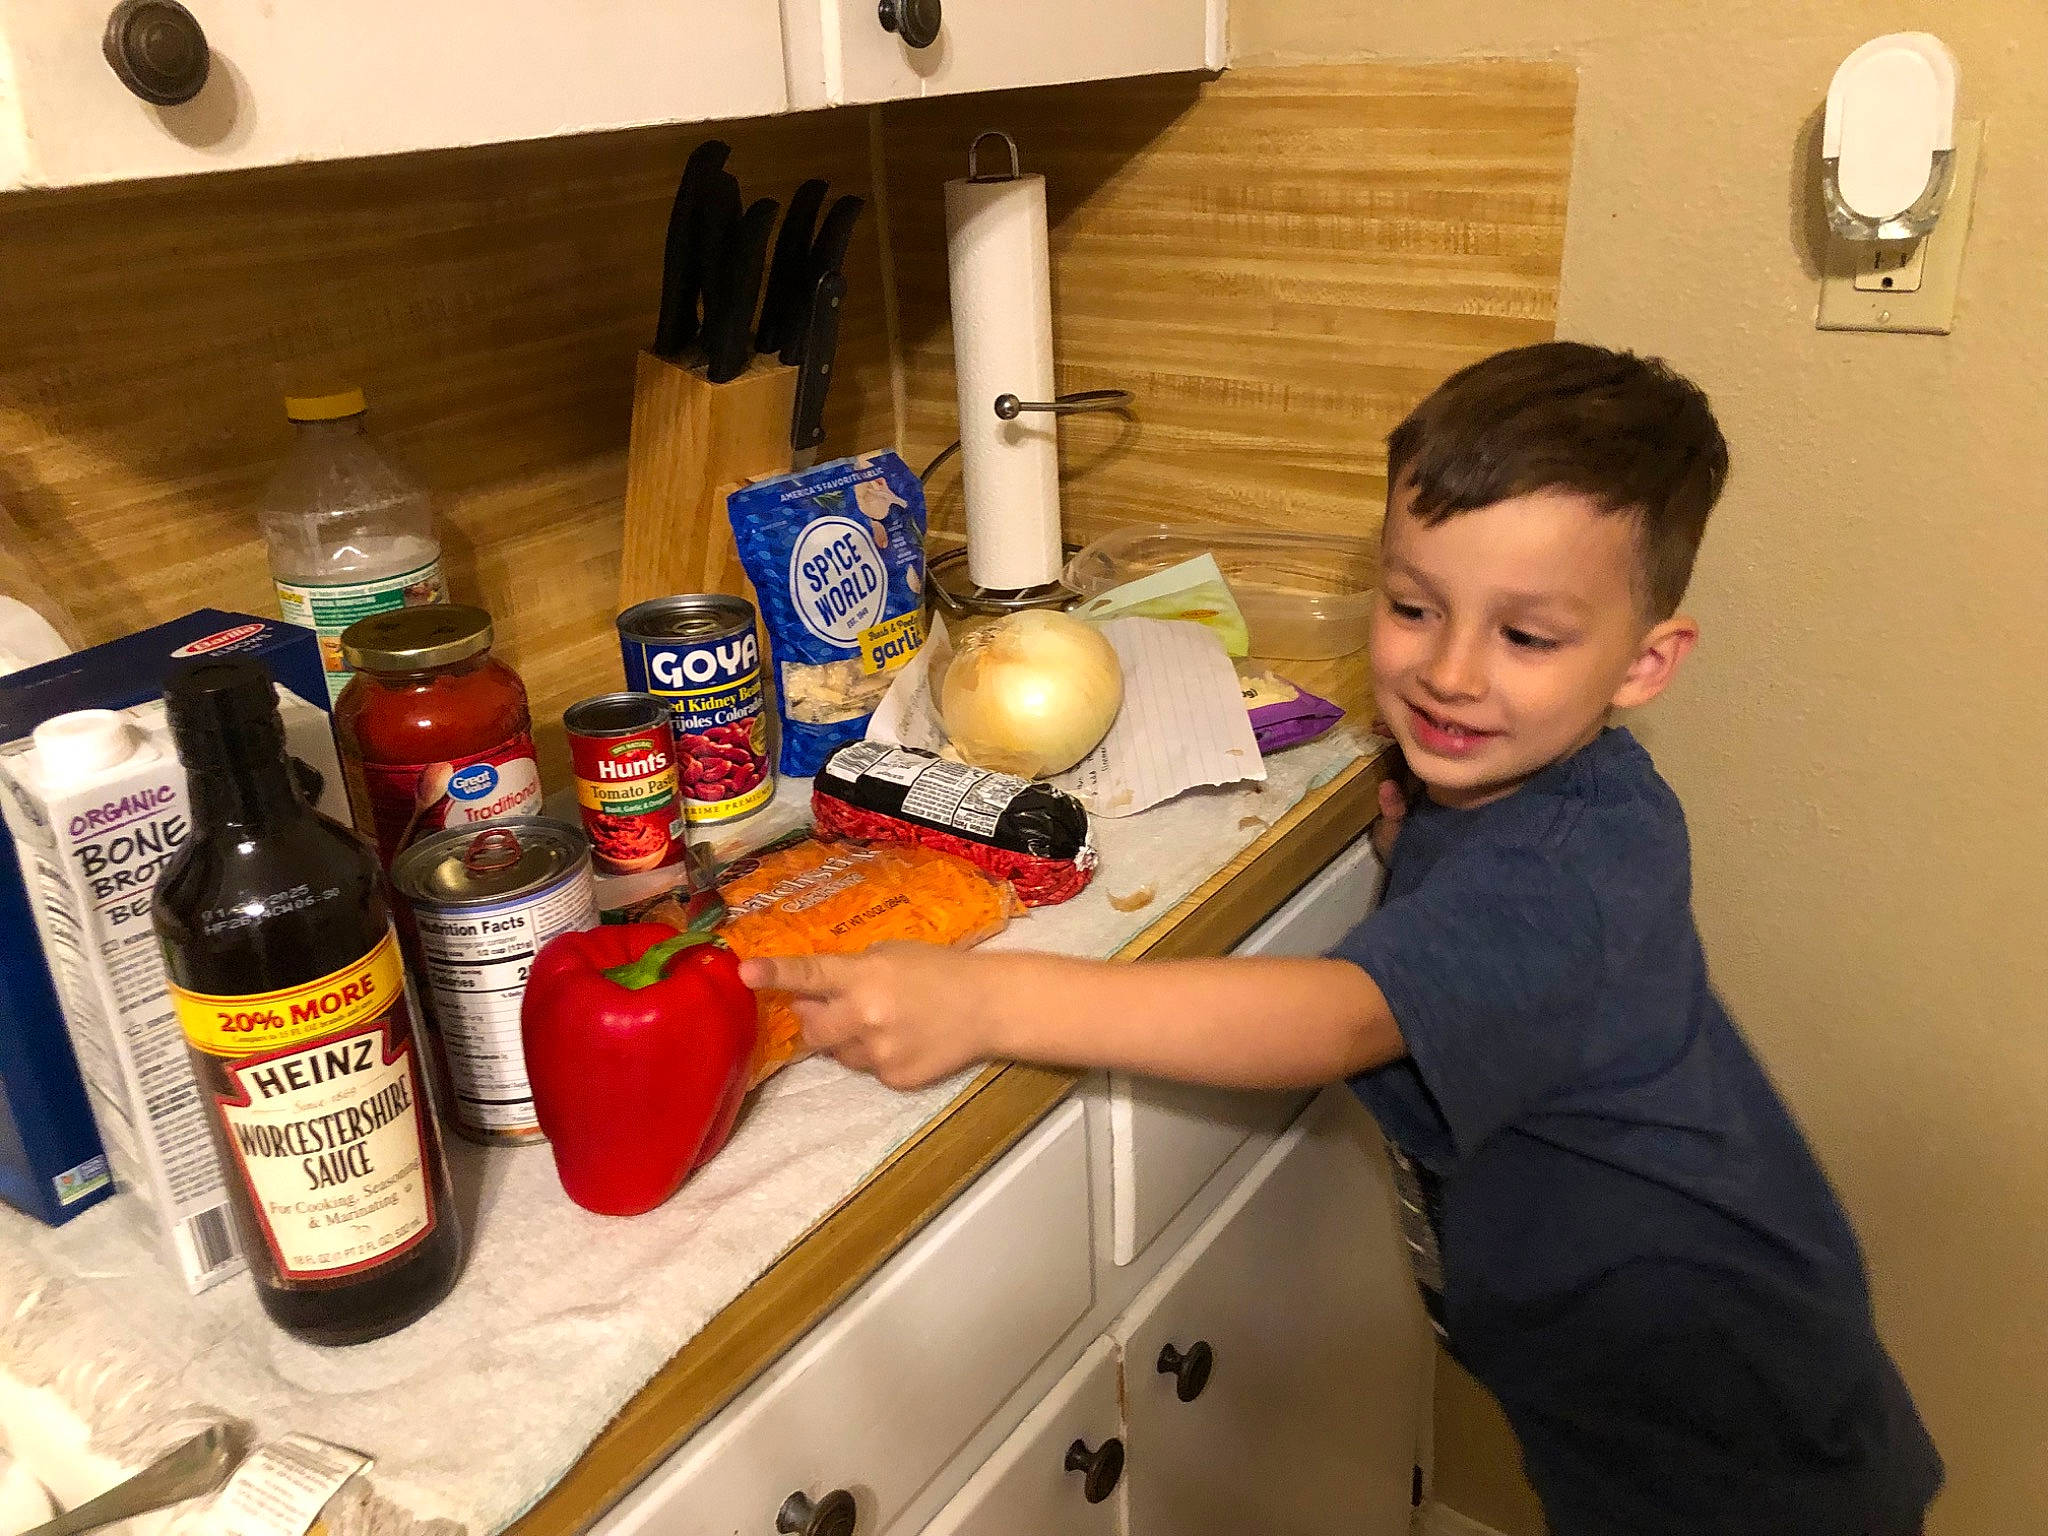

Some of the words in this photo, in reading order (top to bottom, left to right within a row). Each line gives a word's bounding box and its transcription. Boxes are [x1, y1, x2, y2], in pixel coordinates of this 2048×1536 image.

[802, 532, 861, 593] SPICE
[815, 563, 878, 627] WORLD
[651, 633, 759, 688] GOYA
[688, 694, 737, 713] Kidney
[452, 770, 492, 789] Great
[464, 780, 537, 822] Traditiona
[590, 786, 644, 800] Tomato
[68, 785, 177, 836] ORGANIC
[72, 814, 187, 878] BONE
[89, 852, 177, 900] BROT
[481, 917, 525, 934] Facts
[217, 1008, 283, 1033] 20%
[290, 972, 376, 1026] MORE
[250, 1039, 373, 1099] HEINZ
[233, 1082, 413, 1158] WORCESTERSHIRE
[302, 1141, 374, 1191] SAUCE
